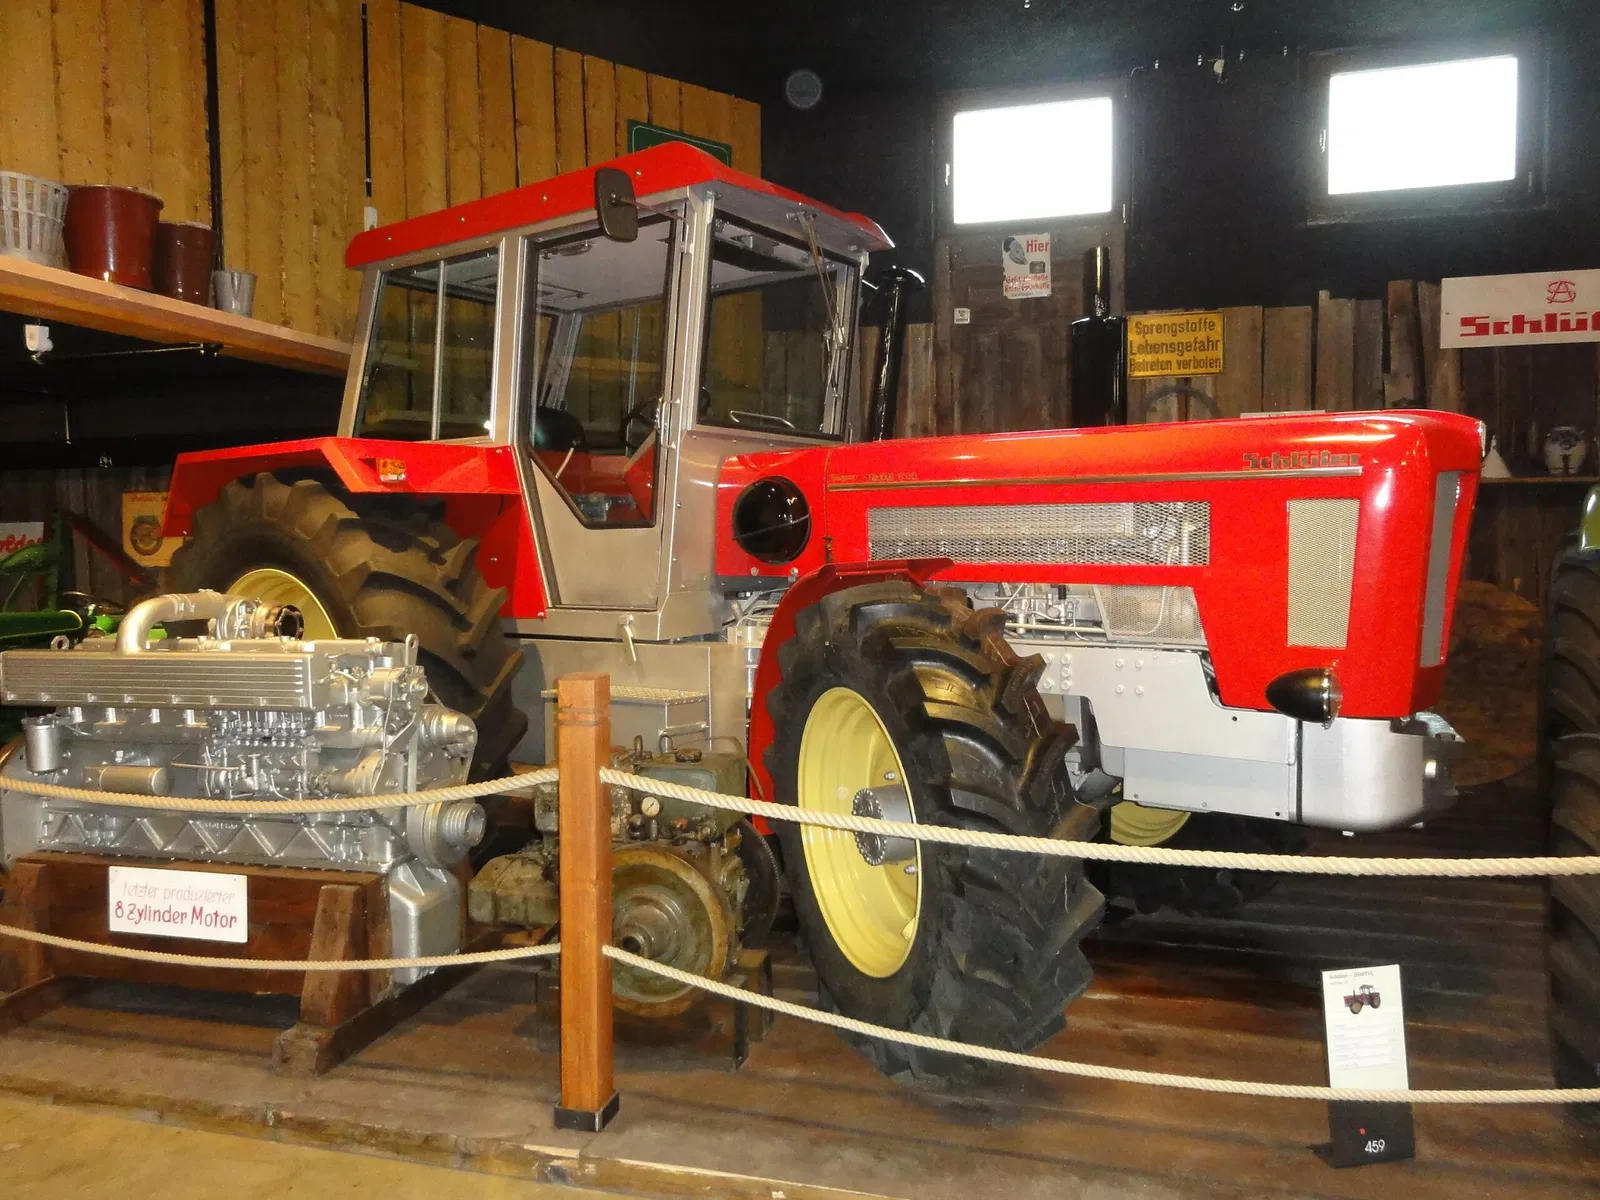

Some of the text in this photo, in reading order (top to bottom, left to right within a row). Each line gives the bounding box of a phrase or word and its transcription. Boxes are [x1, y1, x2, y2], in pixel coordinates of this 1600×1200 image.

[1026, 239, 1049, 252] Hier
[1134, 318, 1216, 338] Sprengstoffe
[1129, 336, 1220, 356] Lebensgefahr
[1176, 355, 1221, 370] verboten
[114, 900, 237, 928] 8 Zylinder Motor
[1364, 1138, 1386, 1153] 459
